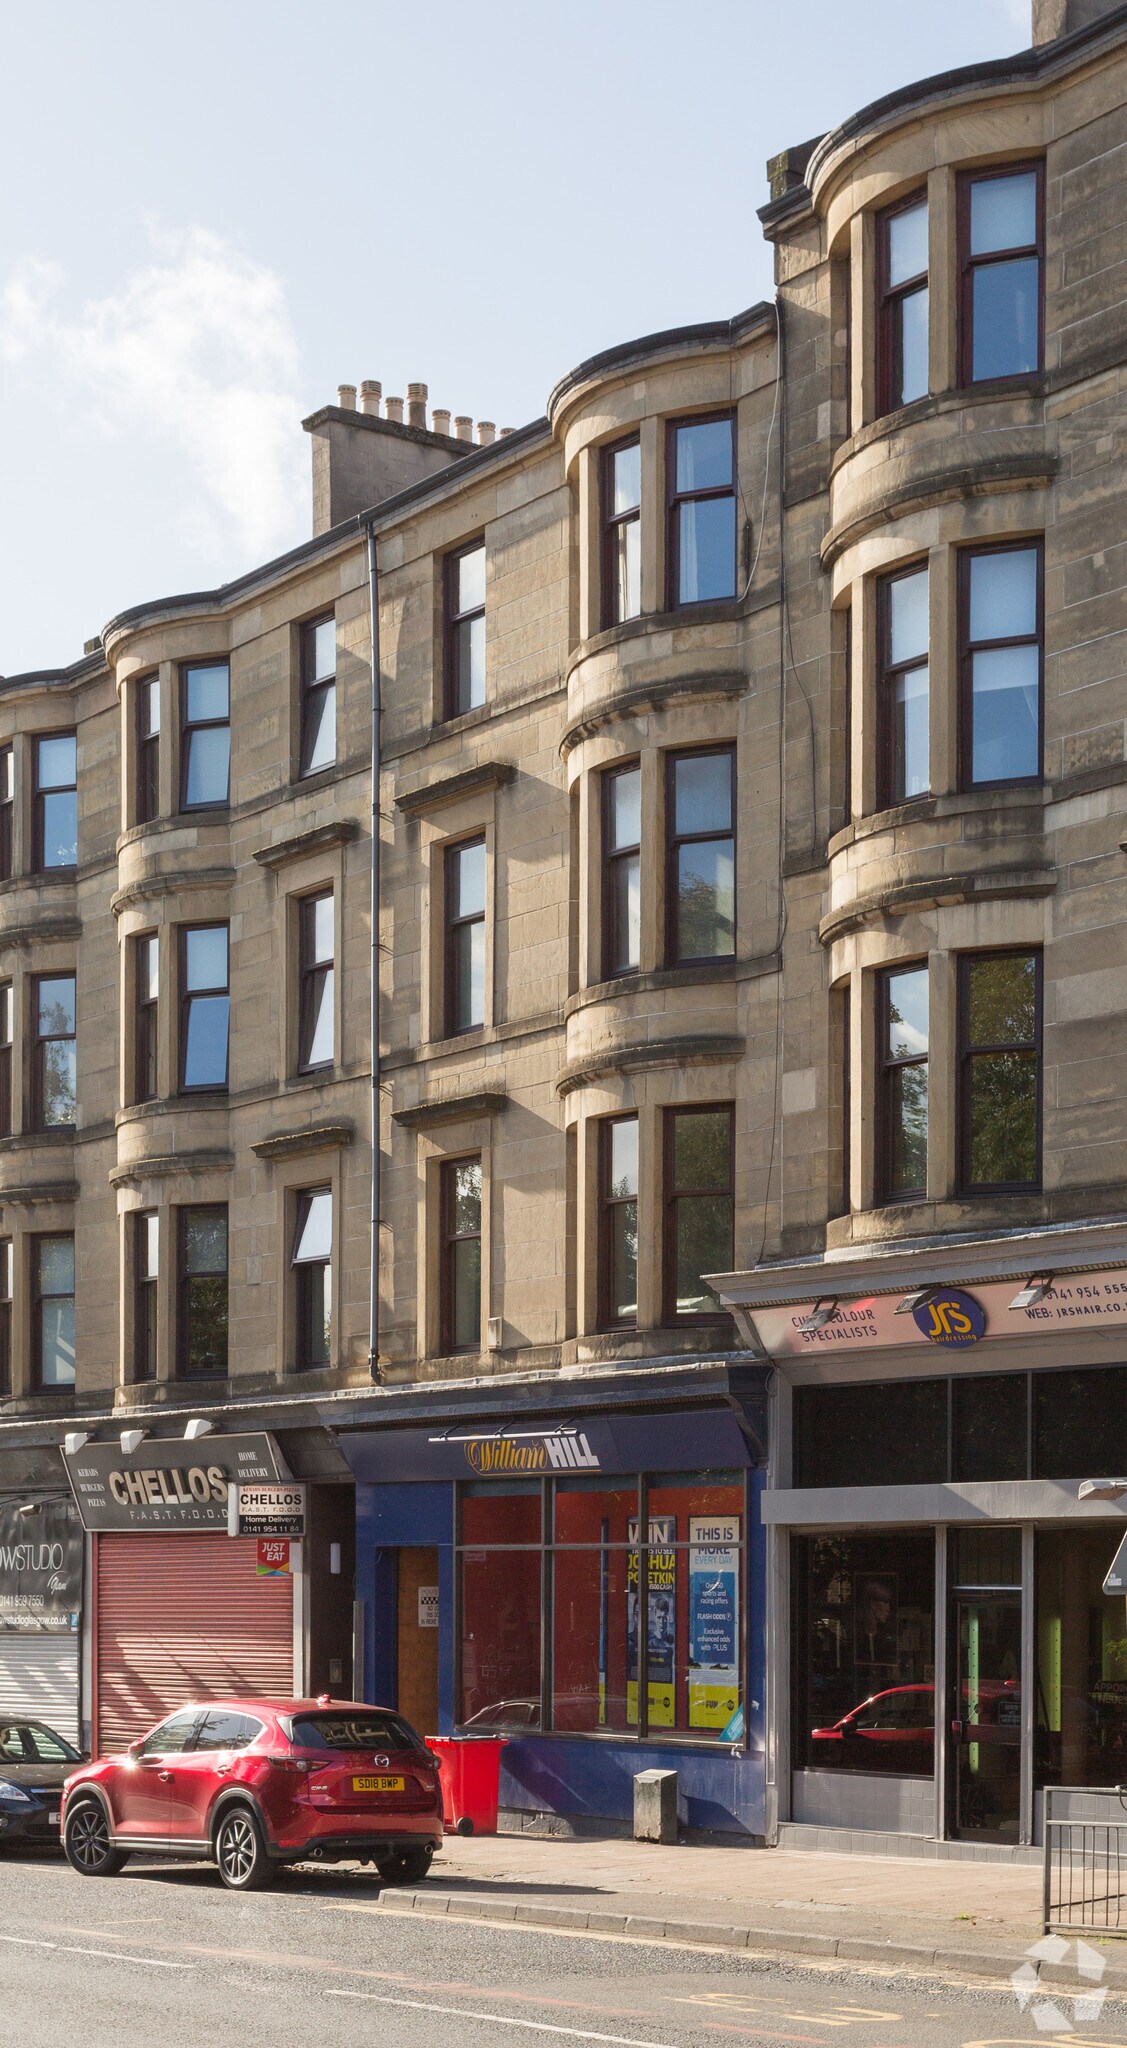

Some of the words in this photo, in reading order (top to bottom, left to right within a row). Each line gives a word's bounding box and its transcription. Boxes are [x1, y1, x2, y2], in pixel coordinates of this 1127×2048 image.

[1076, 1285, 1100, 1299] 954
[1025, 1307, 1054, 1320] WEB:
[1056, 1302, 1127, 1318] JRSHAIR.CO.
[801, 1325, 879, 1343] SPECIALISTS
[543, 1433, 600, 1468] HILL
[237, 1451, 258, 1462] HOME
[76, 1468, 99, 1477] KEBABS
[237, 1467, 269, 1478] DELIVERY
[79, 1483, 106, 1492] BURGERS
[108, 1466, 229, 1506] CHELLOS
[87, 1498, 107, 1507] PIZZAS
[240, 1494, 302, 1505] CHELLOS
[245, 1515, 267, 1523] Home
[268, 1515, 297, 1524] Delivery
[243, 1525, 261, 1533] 0141
[263, 1525, 278, 1533] 954
[279, 1525, 287, 1533] 11
[695, 1527, 721, 1541] THIS
[723, 1527, 734, 1541] IS
[262, 1542, 285, 1553] JUST
[0, 1543, 64, 1571] WSTUDIO
[266, 1552, 285, 1561] EAT
[627, 1554, 676, 1570] JOHUA
[694, 1555, 718, 1565] EVERY
[719, 1555, 733, 1565] DAY
[703, 1627, 725, 1635] Exclusive
[697, 1635, 719, 1643] enhanced
[358, 1778, 379, 1789] SD18
[381, 1778, 399, 1789] BWP
